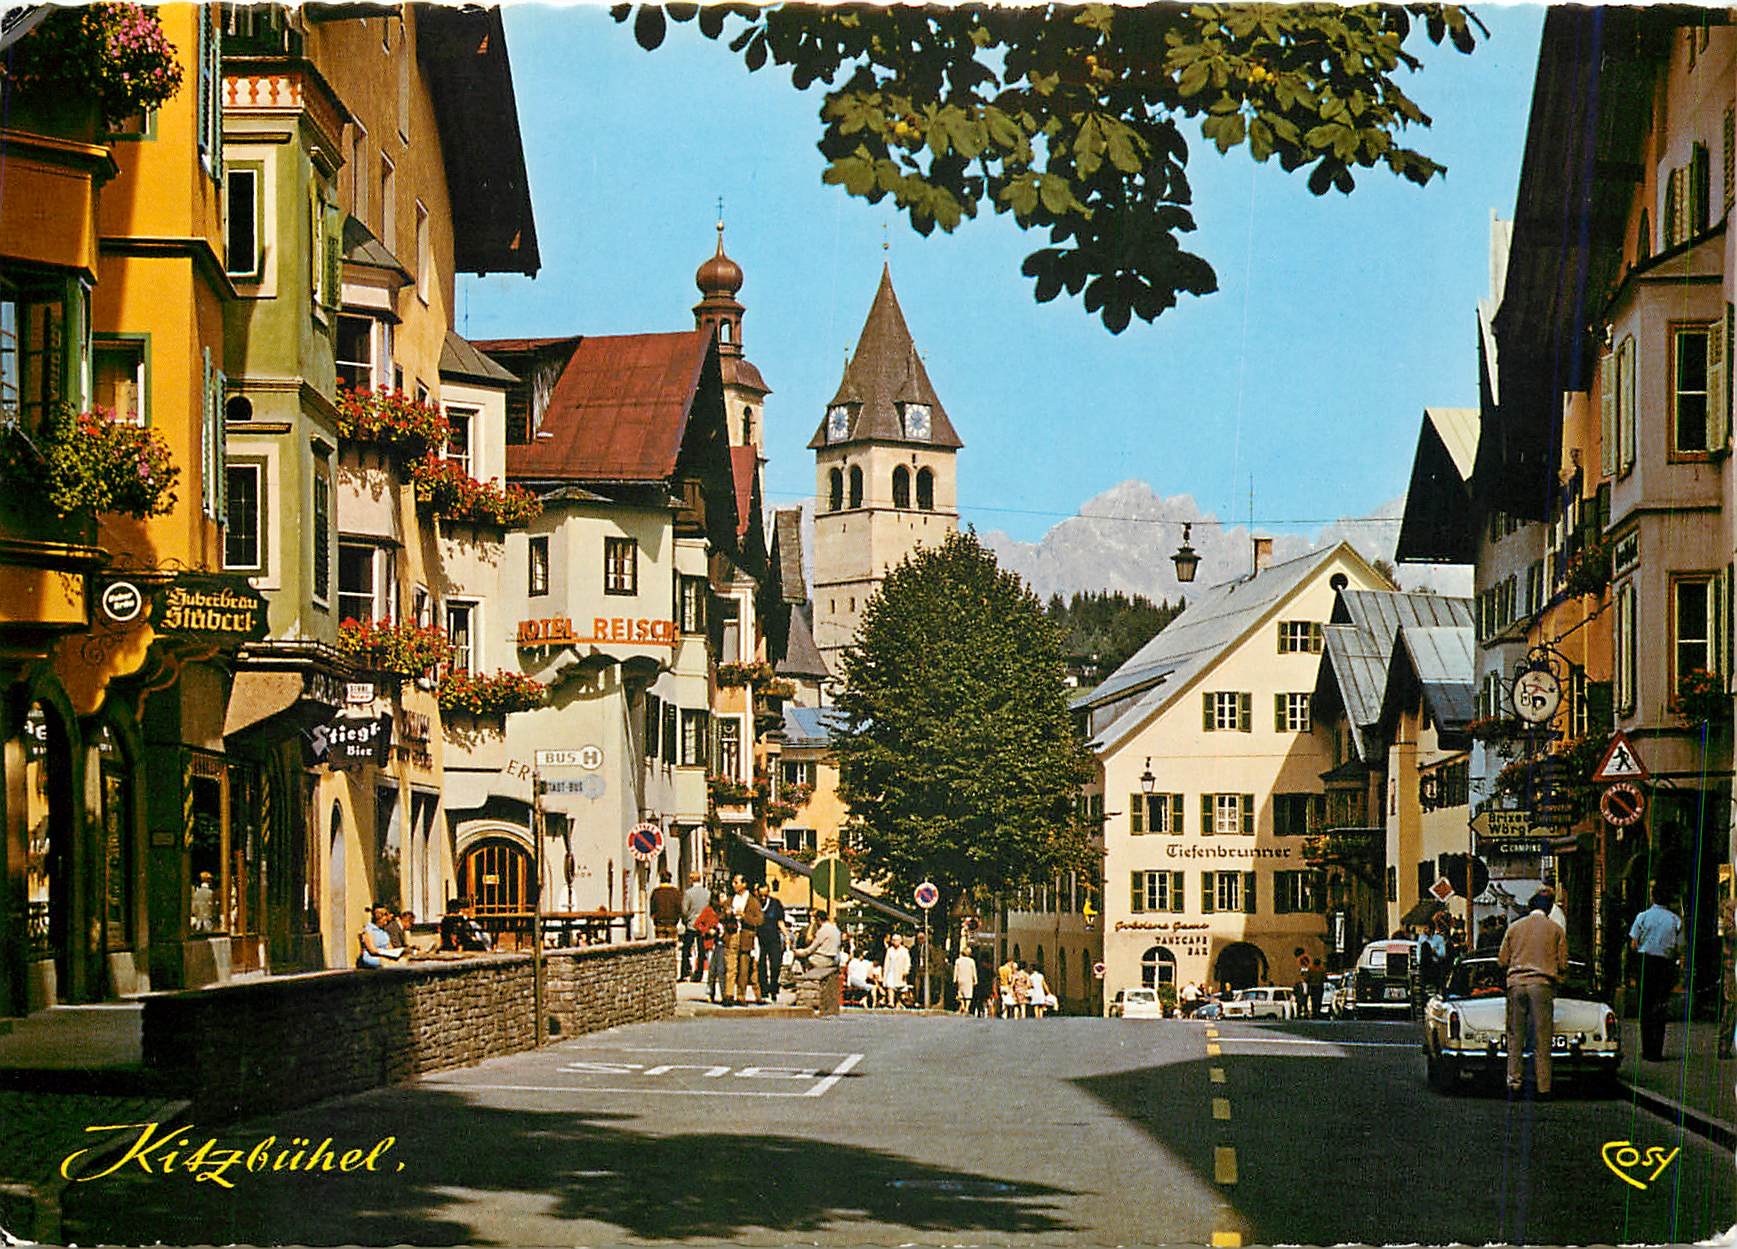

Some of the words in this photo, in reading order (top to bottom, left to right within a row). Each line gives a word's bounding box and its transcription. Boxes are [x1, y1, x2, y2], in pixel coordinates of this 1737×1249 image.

[166, 586, 258, 609] Huberbräu
[346, 745, 373, 756] Bier
[545, 752, 577, 764] BUS
[1165, 843, 1291, 859] Tiefenbrunner
